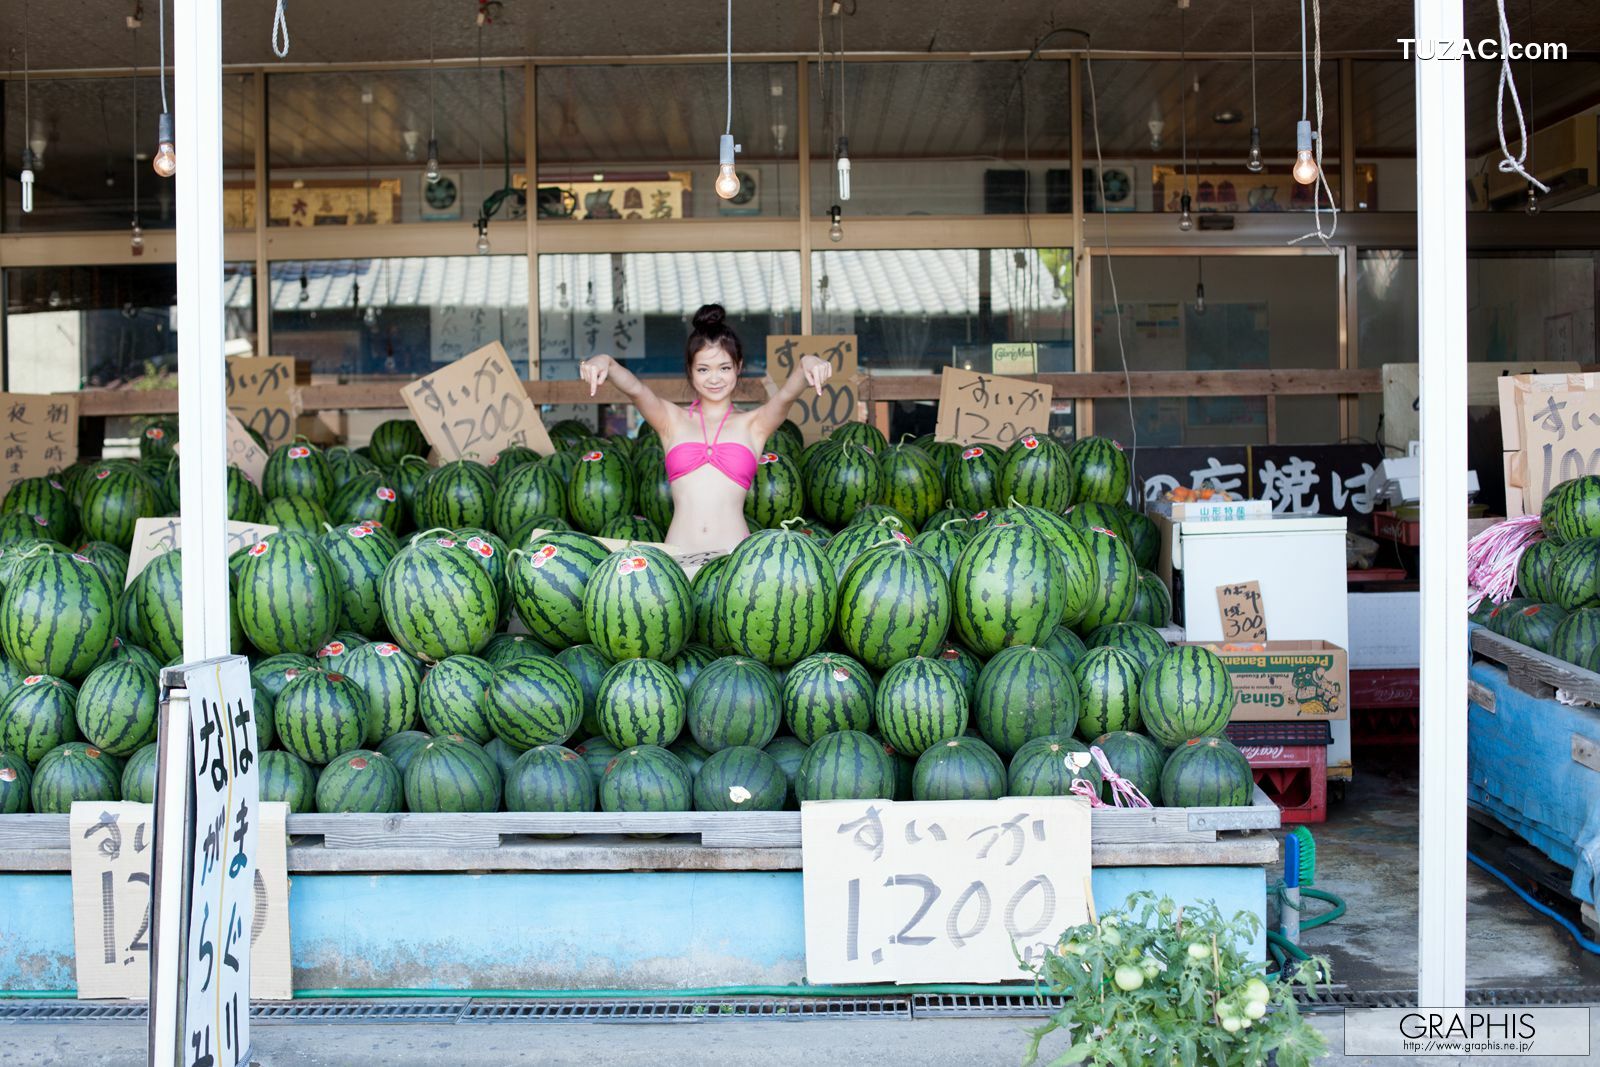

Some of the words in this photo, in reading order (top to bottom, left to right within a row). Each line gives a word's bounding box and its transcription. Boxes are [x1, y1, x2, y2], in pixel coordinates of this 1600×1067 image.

[413, 357, 504, 418] すいか
[958, 375, 1044, 415] すいか
[1270, 656, 1329, 667] Premium
[1241, 693, 1285, 708] Gina
[837, 806, 1046, 866] すいか
[224, 697, 253, 1067] はまぐり
